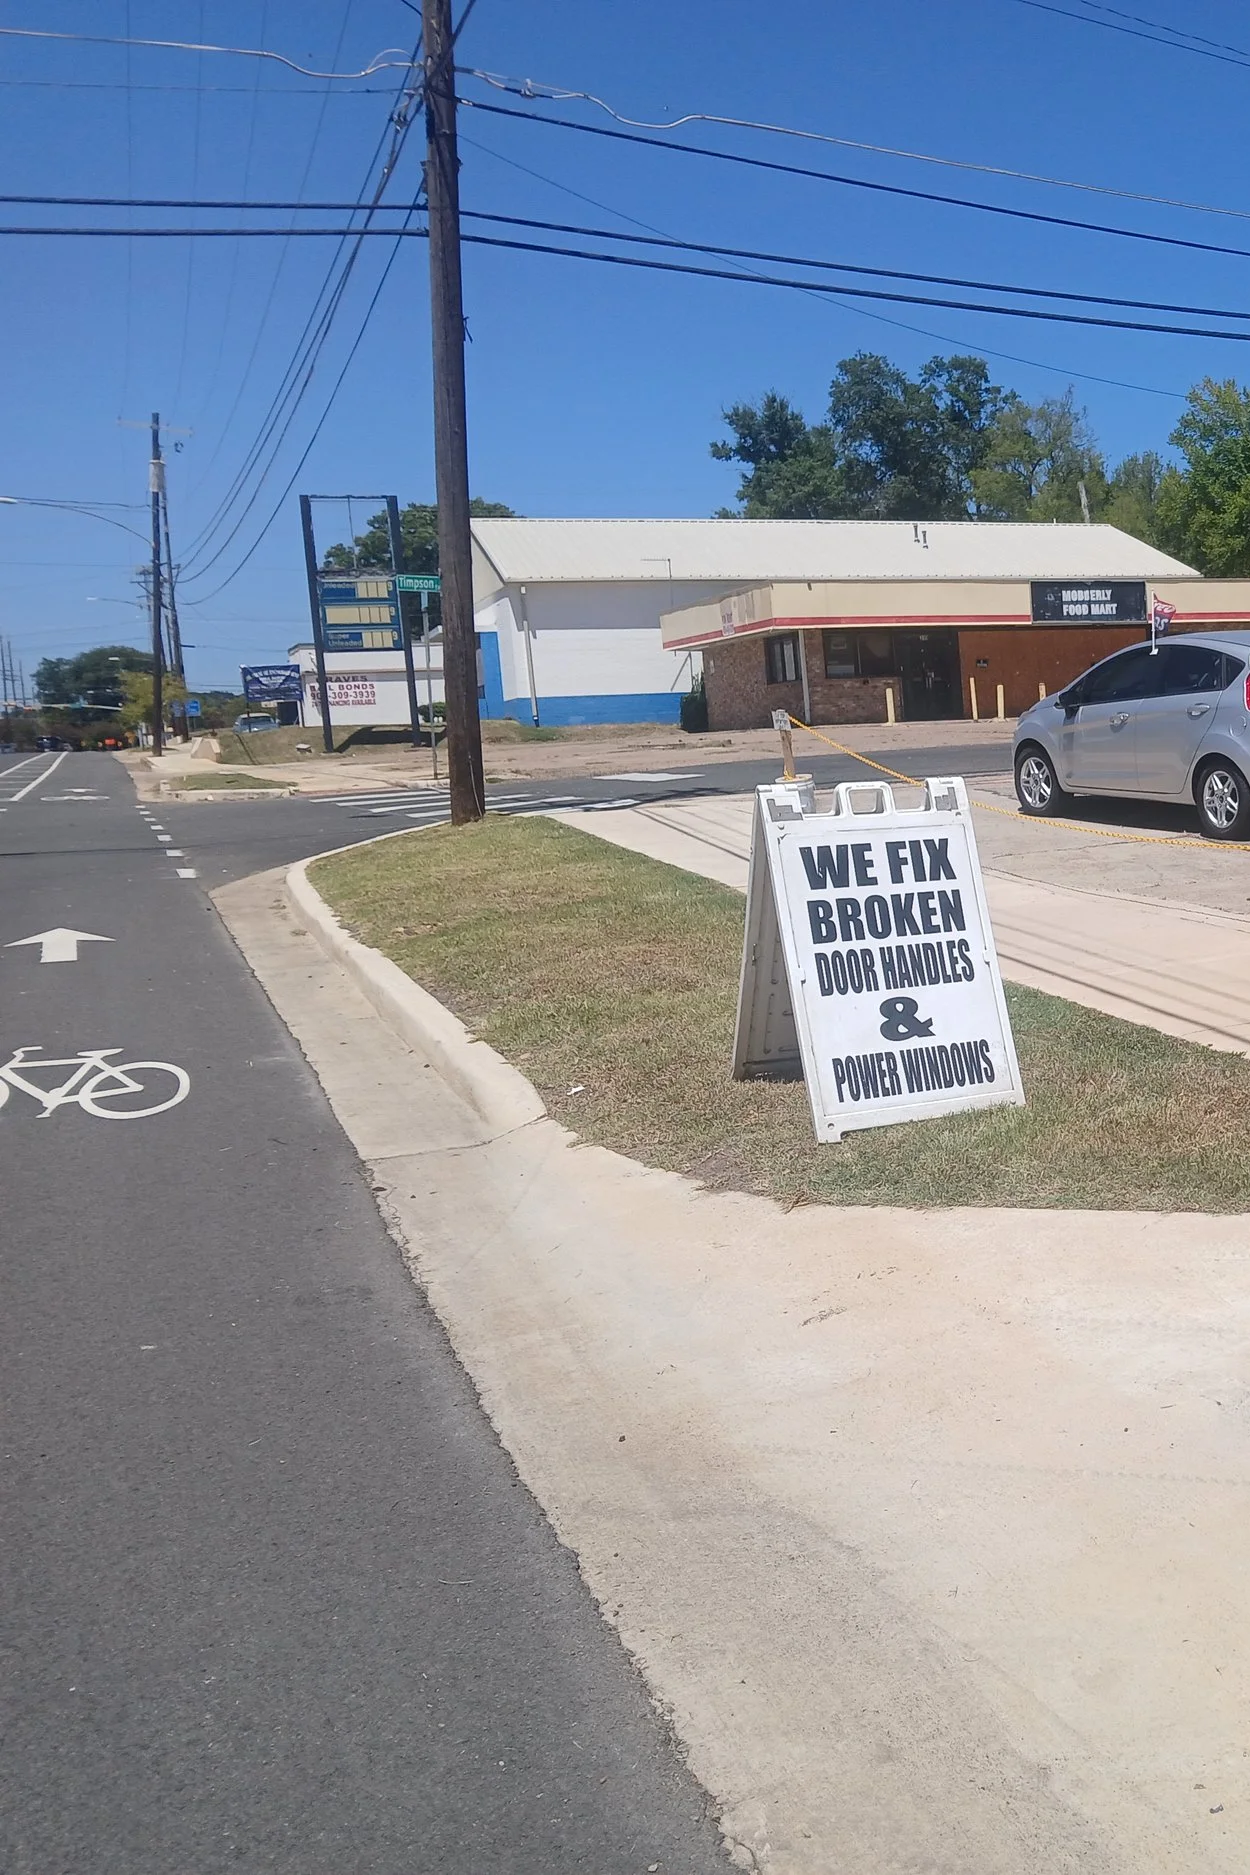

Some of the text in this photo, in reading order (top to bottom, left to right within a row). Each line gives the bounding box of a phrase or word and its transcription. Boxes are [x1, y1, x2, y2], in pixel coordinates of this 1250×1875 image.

[399, 577, 434, 589] Timpson
[390, 607, 396, 616] 9
[1063, 603, 1118, 616] FOOD MART
[392, 631, 398, 640] 9
[338, 683, 375, 691] BONDS
[799, 838, 957, 890] WE FIX
[806, 889, 966, 945] BROKEN
[814, 938, 975, 997] DOOR HANDLES
[879, 996, 936, 1042] &
[832, 1039, 995, 1103] POWER WINDOWS
